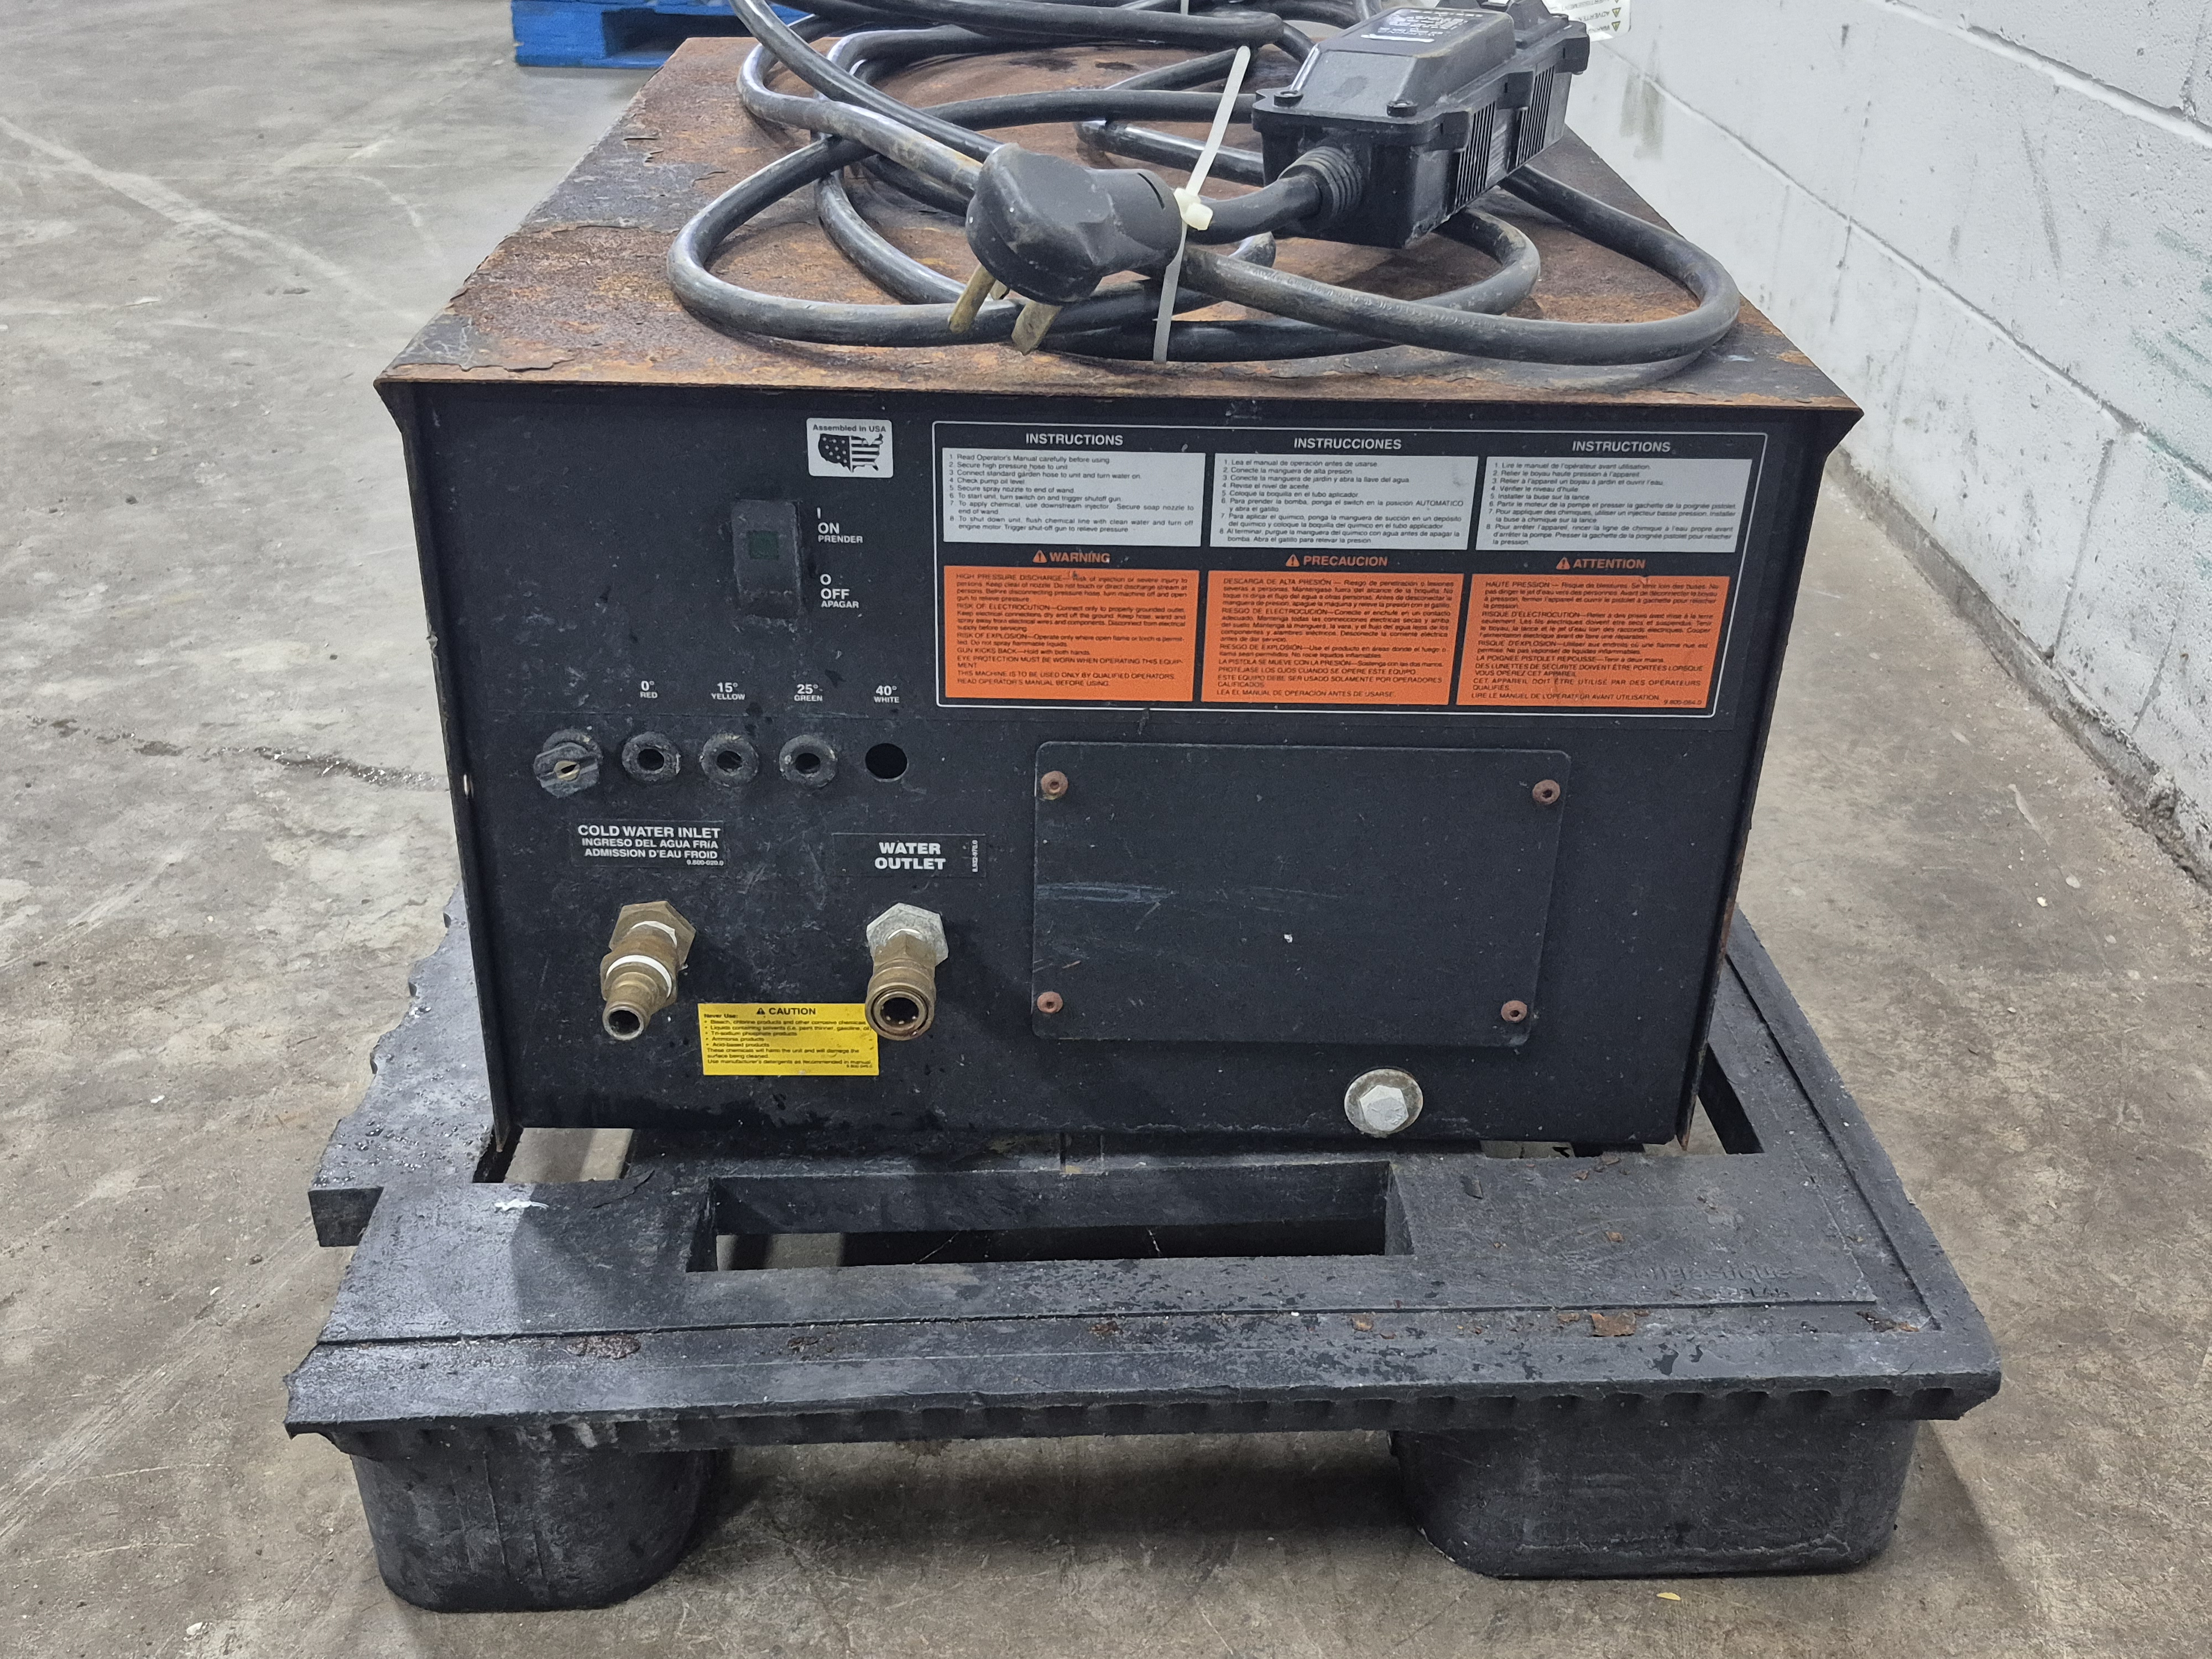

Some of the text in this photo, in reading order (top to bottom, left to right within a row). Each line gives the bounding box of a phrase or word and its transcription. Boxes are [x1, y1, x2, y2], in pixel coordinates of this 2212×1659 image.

[813, 424, 857, 432] Assembled
[1025, 432, 1124, 446] INSTRUCTIONS
[1293, 437, 1402, 450] INSTRUCCIONES
[1572, 440, 1671, 453] INSTRUCTIONS
[817, 522, 839, 534] ON
[818, 535, 863, 543] PRENDER
[1049, 552, 1110, 564] WARNING
[1303, 555, 1388, 567] PRECAUCION
[1572, 559, 1646, 570] ATTENTION
[821, 588, 850, 599] OFF
[821, 600, 859, 608] APAGAR
[640, 680, 655, 691] 0°
[717, 682, 738, 693] 15°
[796, 684, 818, 694] 25°
[875, 685, 897, 696] 40°
[578, 825, 721, 838] COLD WATER INLET
[582, 838, 632, 847] INGRESO
[635, 839, 657, 848] DEL
[660, 839, 691, 848] AGUA
[878, 842, 941, 854] WATER
[585, 848, 718, 859] ADMISSION D'EAU FROID
[874, 857, 946, 870] OUTLET
[768, 1007, 816, 1015] CAUTION
